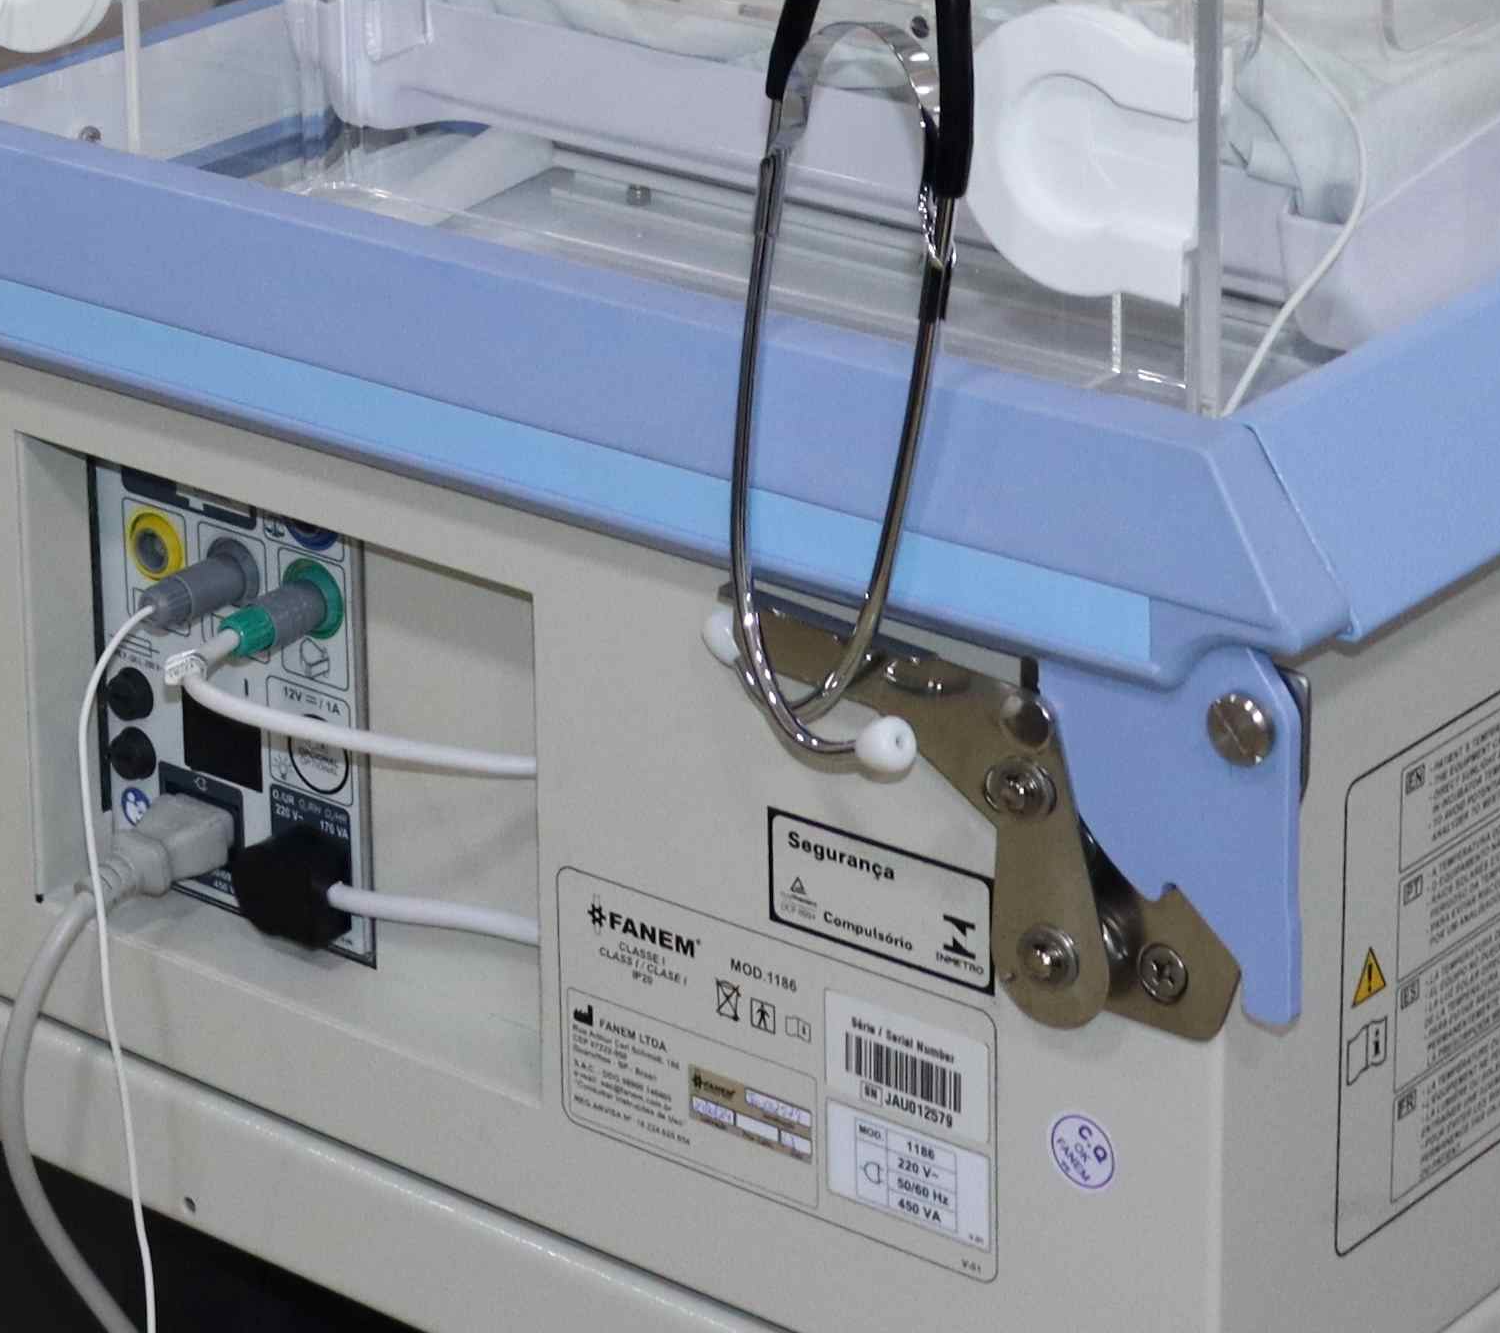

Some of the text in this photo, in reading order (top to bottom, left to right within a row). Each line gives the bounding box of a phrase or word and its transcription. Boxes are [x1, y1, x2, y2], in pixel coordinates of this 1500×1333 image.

[284, 686, 302, 702] 12V
[327, 701, 341, 716] 1A
[788, 831, 895, 881] Segurança
[608, 911, 696, 958] FANEM
[823, 910, 913, 951] Compulsório
[599, 946, 633, 968] CLASS
[646, 963, 682, 984] CLASE
[619, 940, 658, 964] CLASSE
[936, 951, 984, 975] INMETRO
[730, 958, 798, 993] MOD.1186
[599, 1018, 668, 1053] FANEM LTDA
[851, 1016, 876, 1036] Série
[885, 1028, 914, 1049] Serial
[916, 1039, 955, 1064] Number
[885, 1091, 954, 1129] JAU012579
[858, 1124, 882, 1140] MOD.
[898, 1157, 920, 1176] 220
[906, 1140, 936, 1162] 1186
[897, 1177, 949, 1206] 50/60 Hz
[898, 1196, 942, 1223] 450 VA
